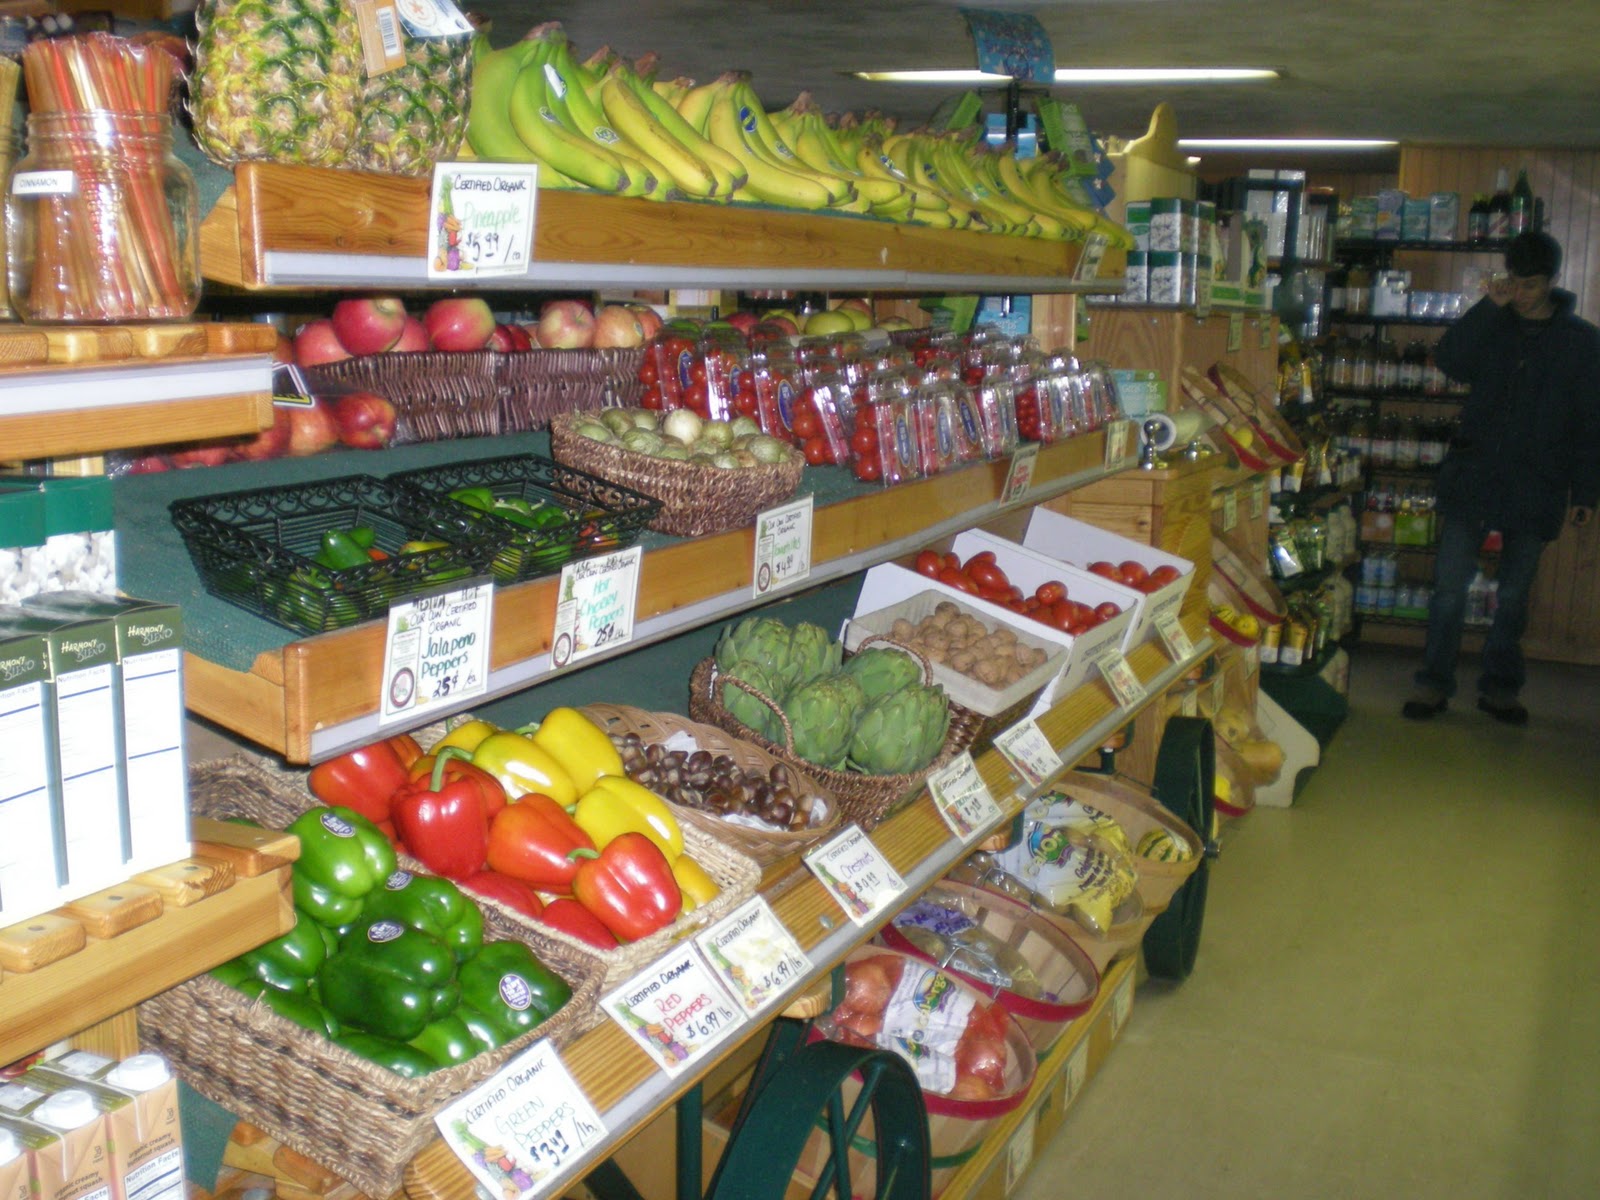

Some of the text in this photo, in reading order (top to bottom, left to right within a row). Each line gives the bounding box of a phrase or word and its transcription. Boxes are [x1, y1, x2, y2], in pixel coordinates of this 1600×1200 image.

[19, 178, 58, 188] CINNAMON
[454, 174, 526, 193] CERTIFIED ORGANIC
[463, 201, 521, 231] Pineapple
[128, 624, 164, 637] HARMONY
[428, 617, 461, 634] ORGANIC
[61, 639, 98, 653] HARMONY
[142, 628, 173, 646] BLEND
[421, 632, 476, 659] Jalapeno
[0, 656, 25, 670] RMONY
[76, 643, 106, 662] BLEND
[3, 660, 34, 681] BLEND
[625, 960, 694, 1008] CERTIFIED ORGANIC
[654, 993, 682, 1015] RED
[663, 994, 712, 1033] PEPPERS
[466, 1058, 547, 1125] CERTIFIED ORGANIC
[495, 1095, 545, 1135] GREEN
[514, 1102, 576, 1150] PEPPERS
[126, 1150, 180, 1183] Nutrition Facts
